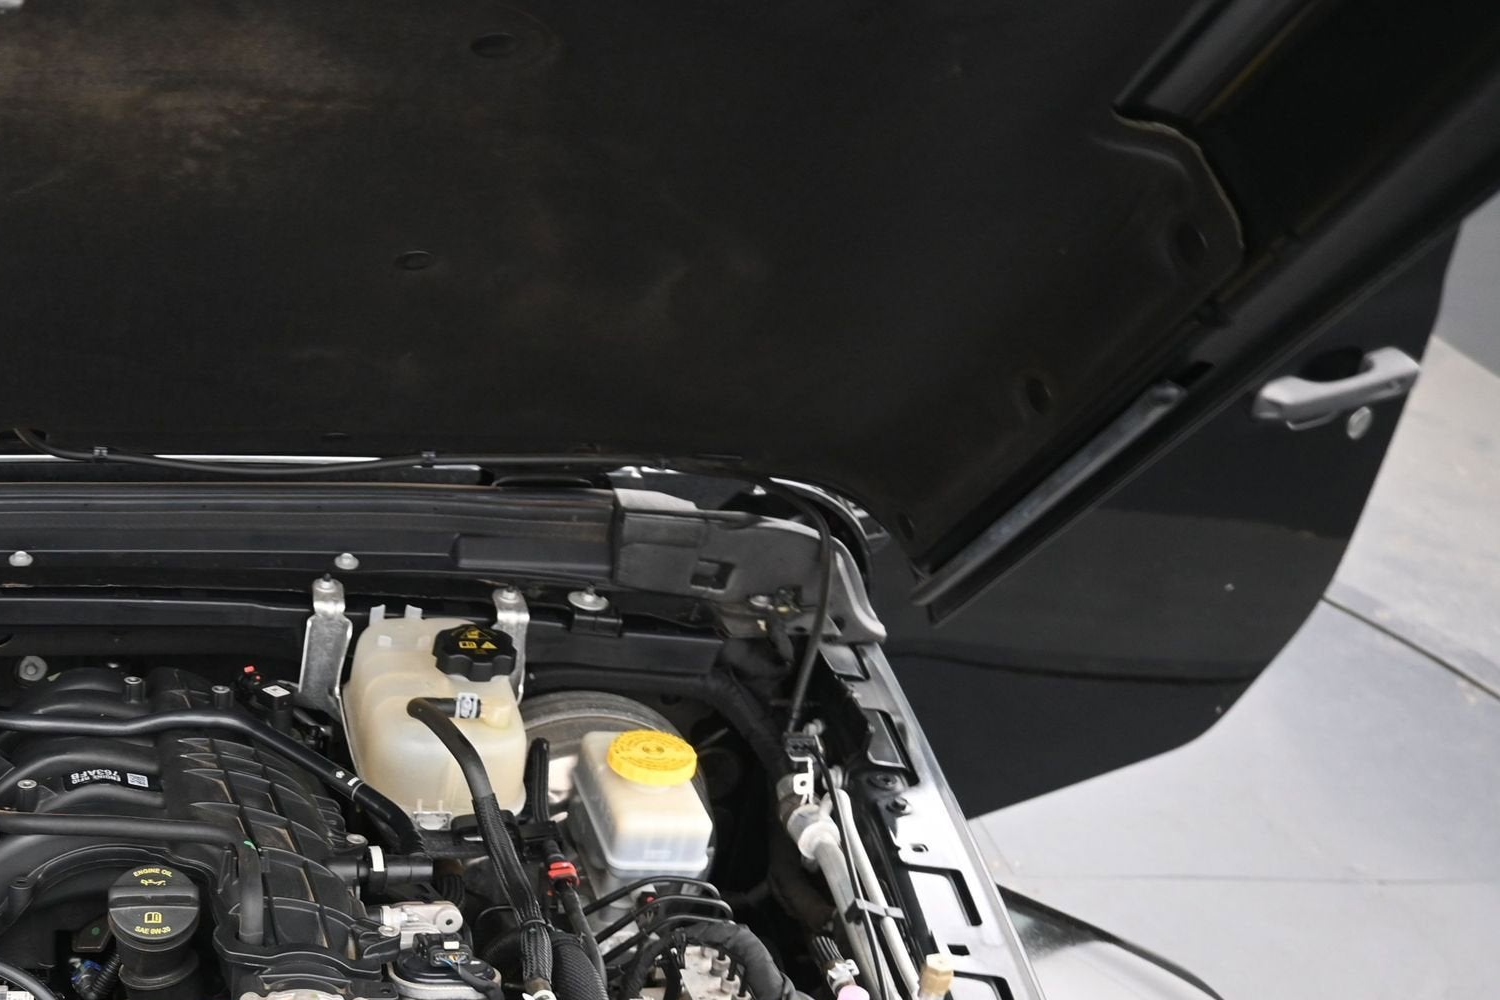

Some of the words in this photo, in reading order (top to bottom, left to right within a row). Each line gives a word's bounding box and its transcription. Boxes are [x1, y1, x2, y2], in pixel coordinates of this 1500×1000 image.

[70, 769, 119, 780] 763AFB
[93, 773, 122, 782] ENGINE
[133, 868, 160, 877] ENGINE
[161, 869, 172, 878] OIL
[134, 926, 150, 935] SAE
[150, 926, 171, 935] 0W-20
